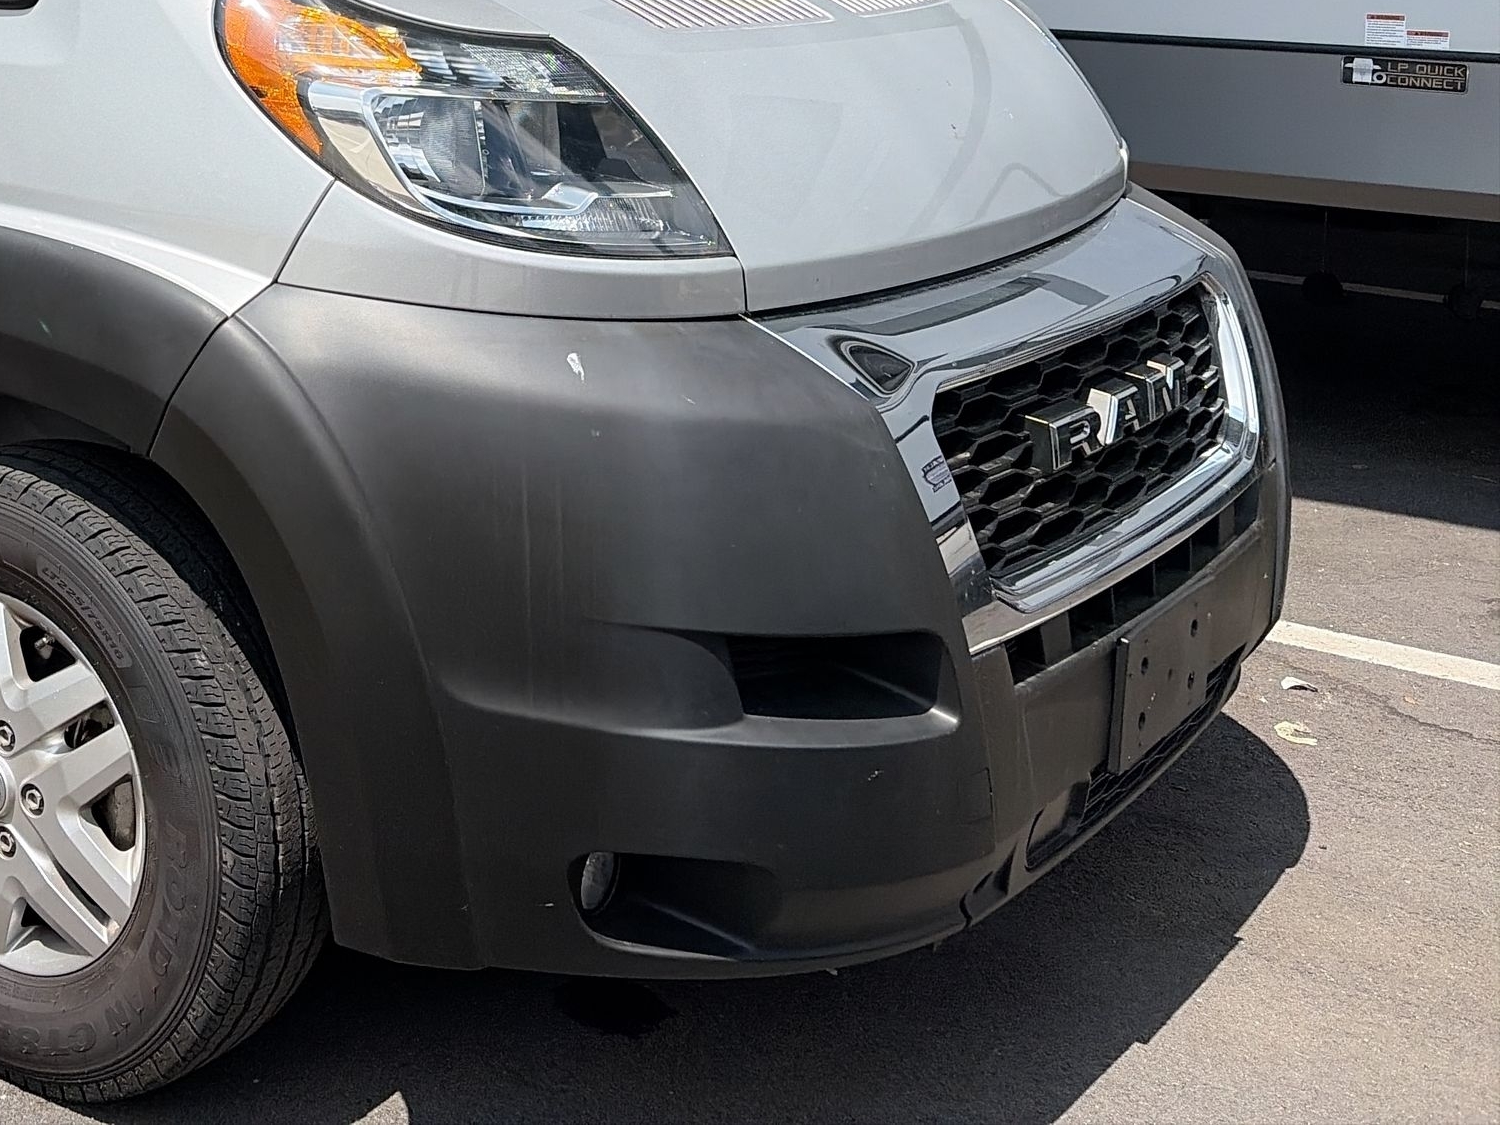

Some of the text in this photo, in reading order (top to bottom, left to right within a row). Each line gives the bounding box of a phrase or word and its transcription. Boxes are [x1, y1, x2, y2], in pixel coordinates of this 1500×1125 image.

[1387, 61, 1466, 78] LP QUICK
[1386, 75, 1466, 90] CONNECT
[1033, 353, 1188, 473] RAM
